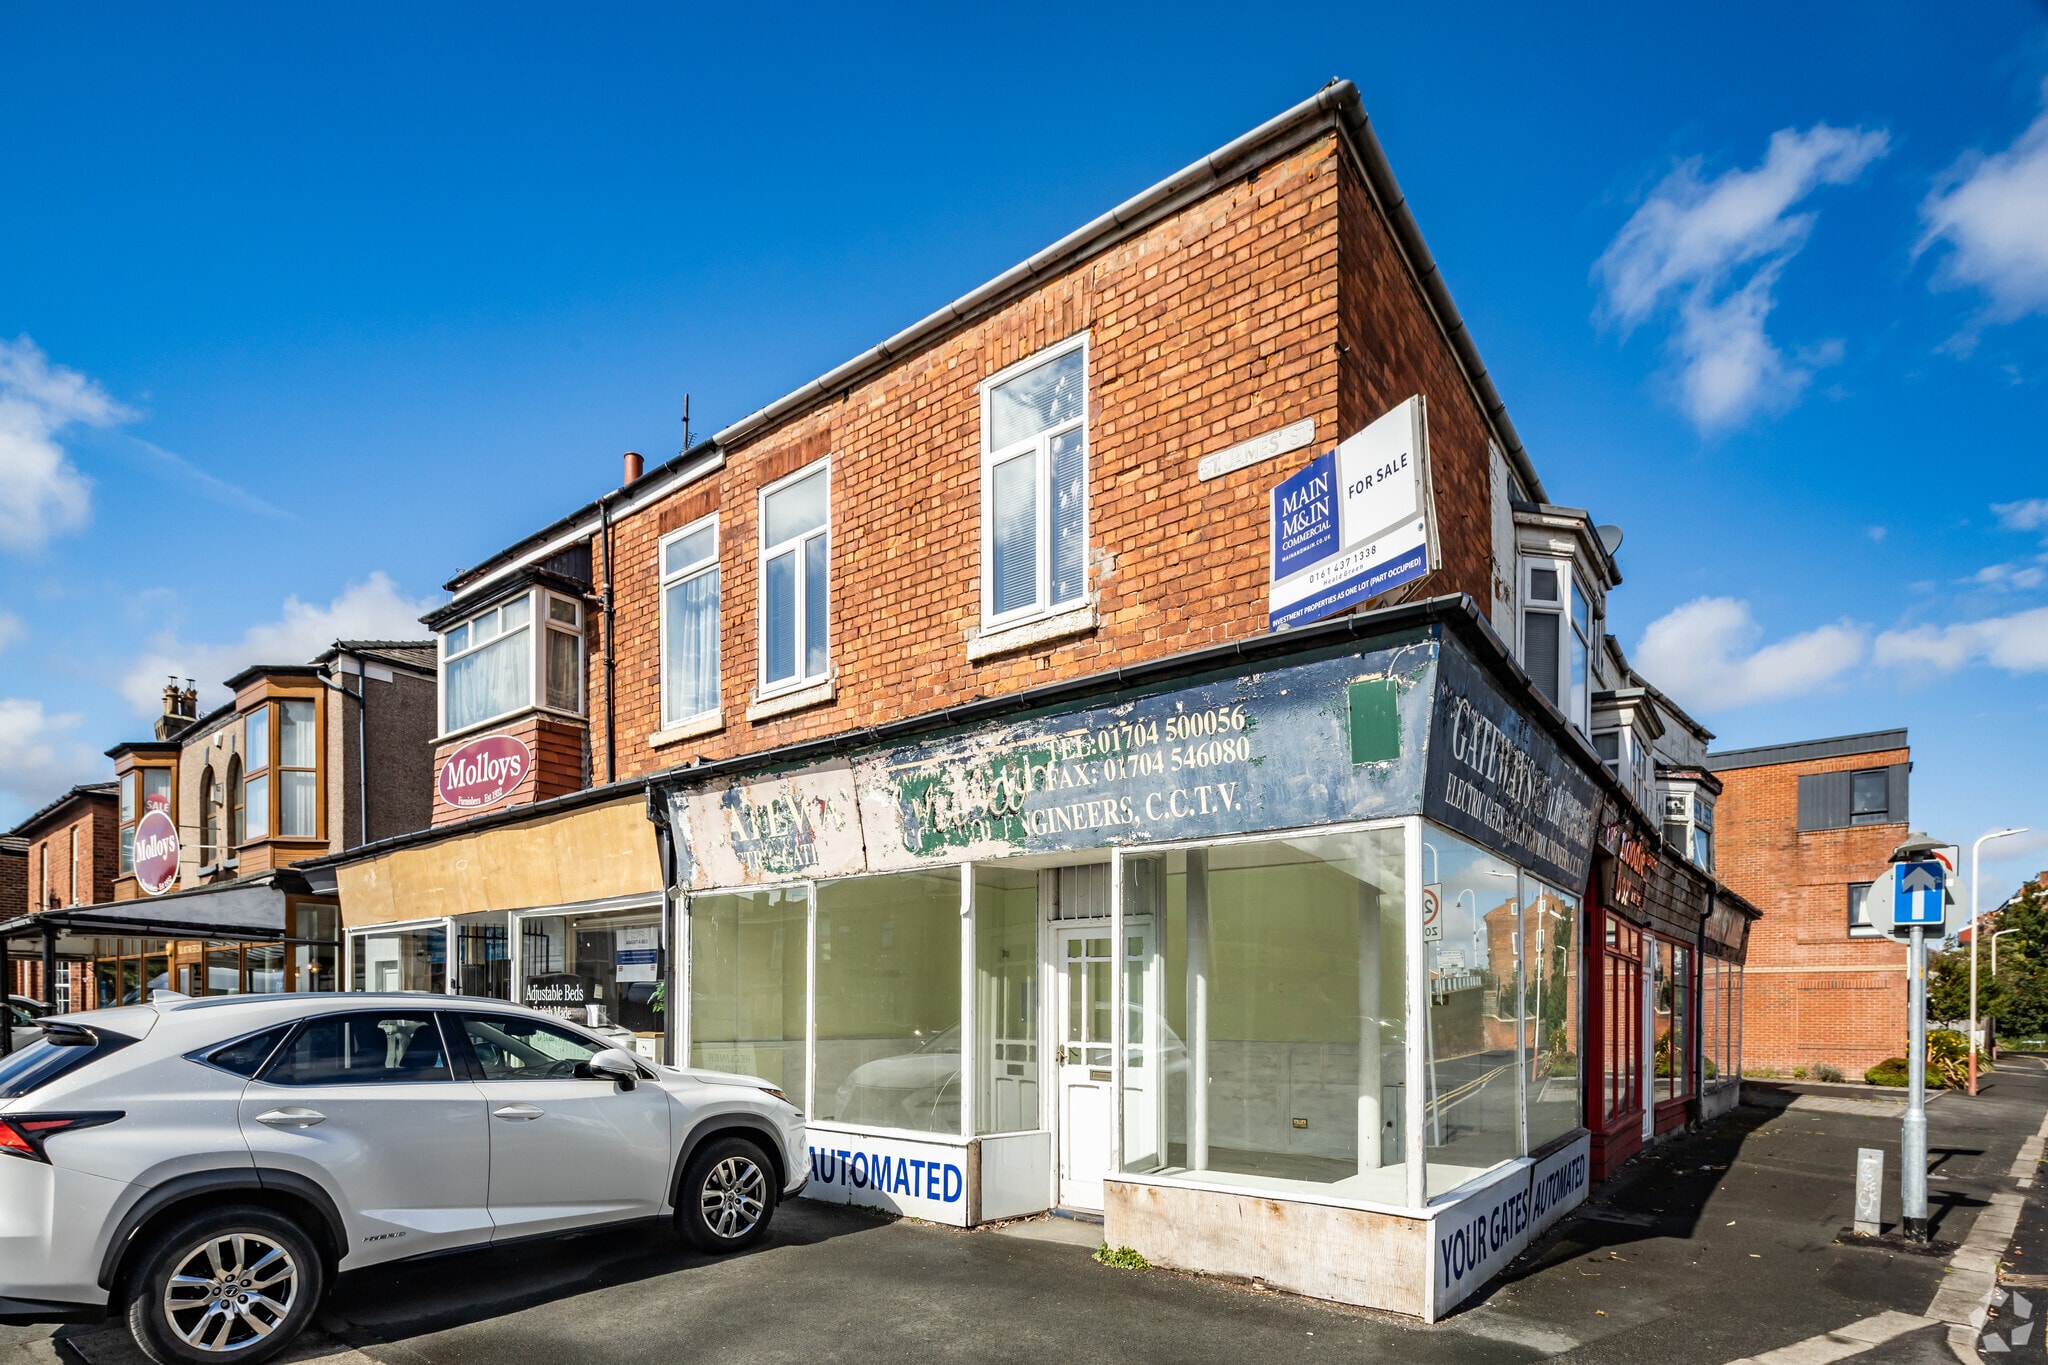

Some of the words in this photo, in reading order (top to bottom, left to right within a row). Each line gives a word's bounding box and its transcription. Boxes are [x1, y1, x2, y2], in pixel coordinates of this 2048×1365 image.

[1281, 471, 1329, 518] MAIN
[1348, 475, 1374, 500] FOR
[1376, 453, 1408, 483] SALE
[1281, 495, 1330, 540] M&IN
[1282, 520, 1331, 551] COMMERCIAL
[1309, 567, 1331, 584] 0161
[1333, 557, 1351, 572] 437
[1353, 545, 1377, 563] 1338
[1323, 572, 1342, 586] Heald
[1343, 564, 1364, 577] Green
[1272, 608, 1304, 627] INVESTMENT
[1303, 593, 1337, 614] PROPERTIES
[1336, 591, 1346, 600] AS
[1345, 585, 1358, 596] ONE
[1357, 580, 1371, 592] LOT
[1369, 571, 1388, 587] (PART
[1387, 556, 1422, 578] OCCUPIED)
[1164, 704, 1246, 743] 500056
[446, 751, 522, 790] Molloys
[1045, 761, 1098, 793] FAX:
[1103, 749, 1165, 782] 01704
[1170, 736, 1251, 773] 546080
[146, 800, 170, 812] SALE
[1145, 781, 1242, 822] C.C.T.V.
[1444, 771, 1487, 822] ELECTRIC
[135, 834, 176, 863] Molloys
[525, 983, 563, 1005] Adjustable
[564, 983, 584, 1002] Beds
[1441, 1214, 1487, 1289] YOUR
[1489, 1188, 1529, 1253] GATES
[1532, 1153, 1586, 1223] AUTOMATED
